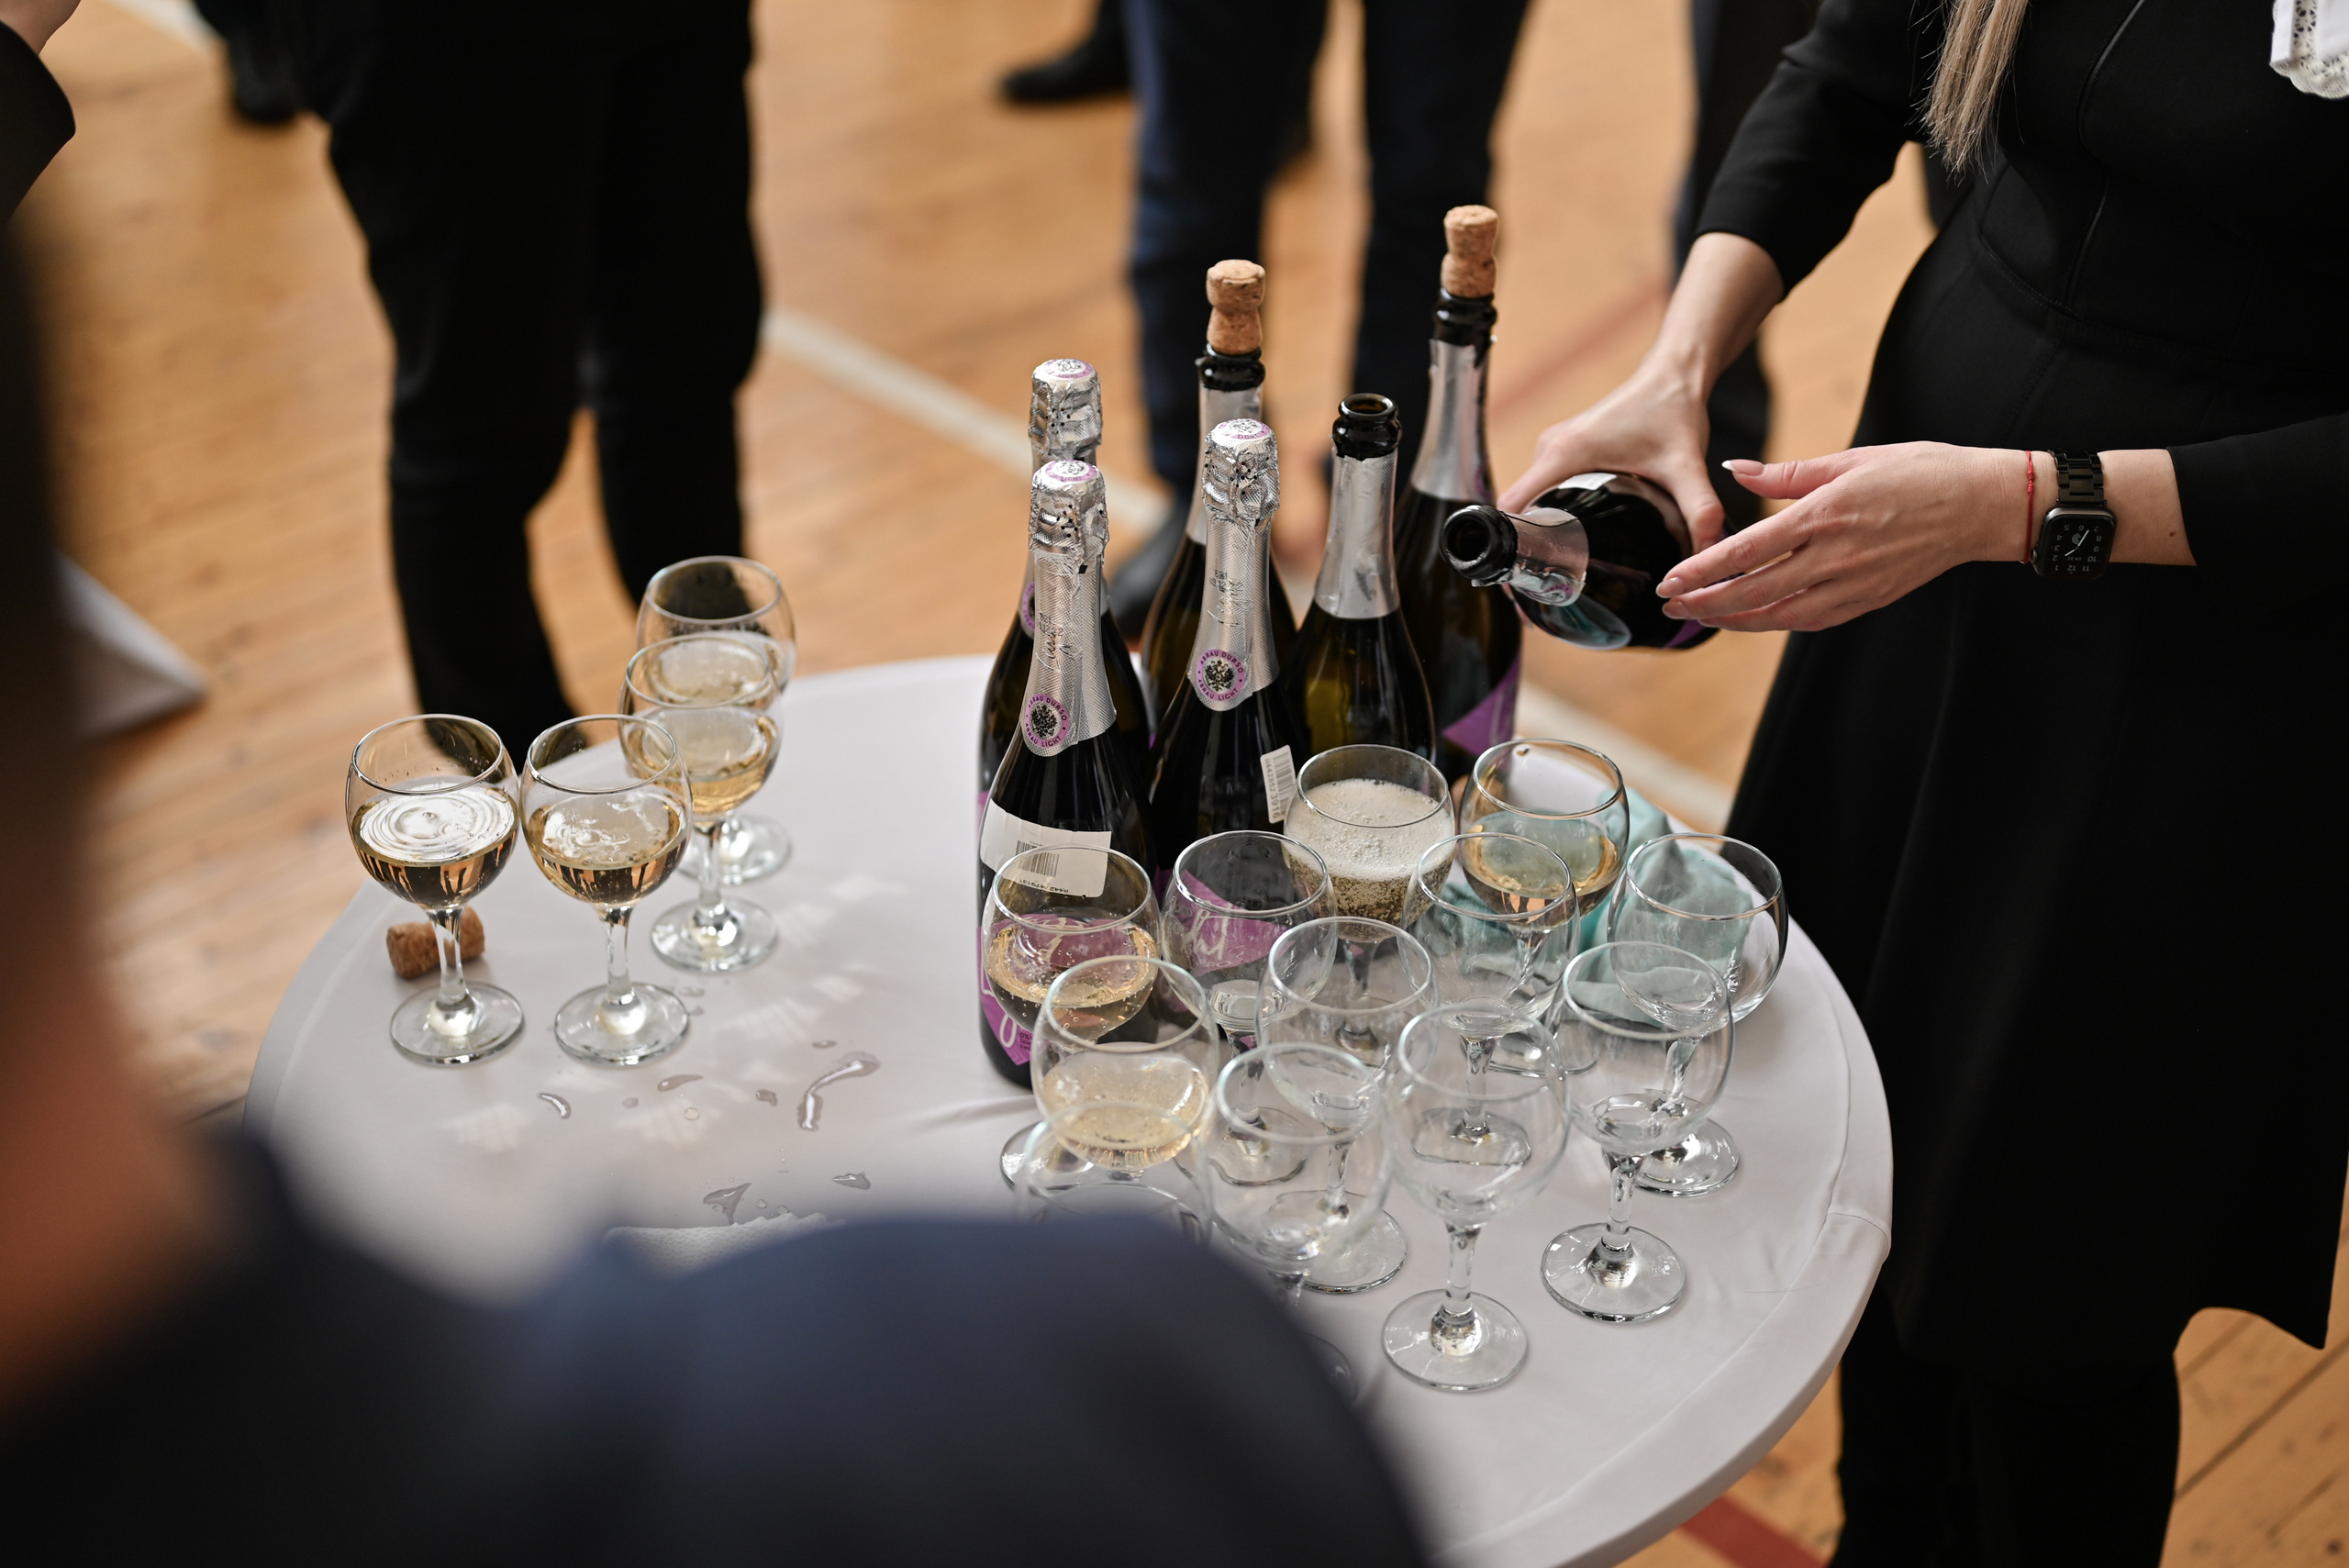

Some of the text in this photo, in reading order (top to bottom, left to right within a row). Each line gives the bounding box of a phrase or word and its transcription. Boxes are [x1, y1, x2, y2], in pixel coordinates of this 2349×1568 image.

[1199, 651, 1244, 673] ABRAU DURSO
[1197, 679, 1239, 701] ABRAU LIGHT
[1028, 695, 1068, 721] ABRAU DURSO
[1025, 723, 1062, 748] ABRAU LIGHT
